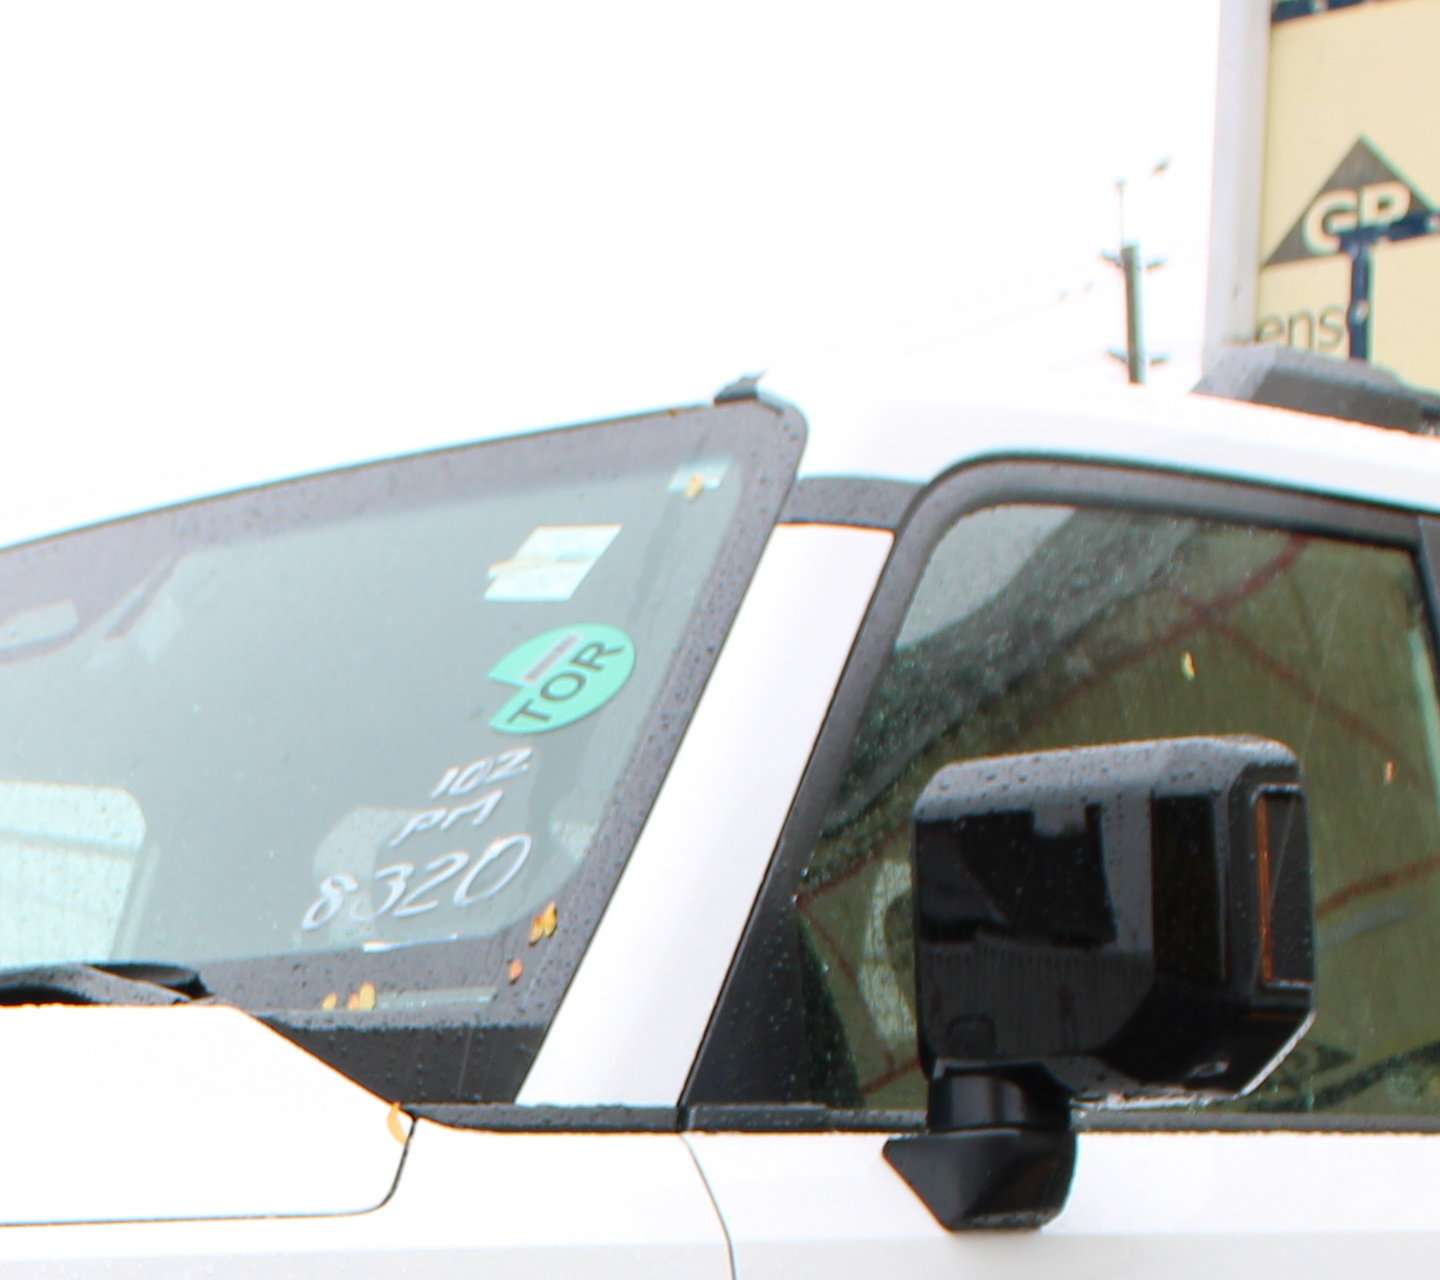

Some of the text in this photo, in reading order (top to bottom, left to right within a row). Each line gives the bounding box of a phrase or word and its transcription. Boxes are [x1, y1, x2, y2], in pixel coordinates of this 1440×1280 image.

[506, 640, 624, 723] TOR
[389, 788, 503, 847] PM
[303, 834, 531, 930] 8320
